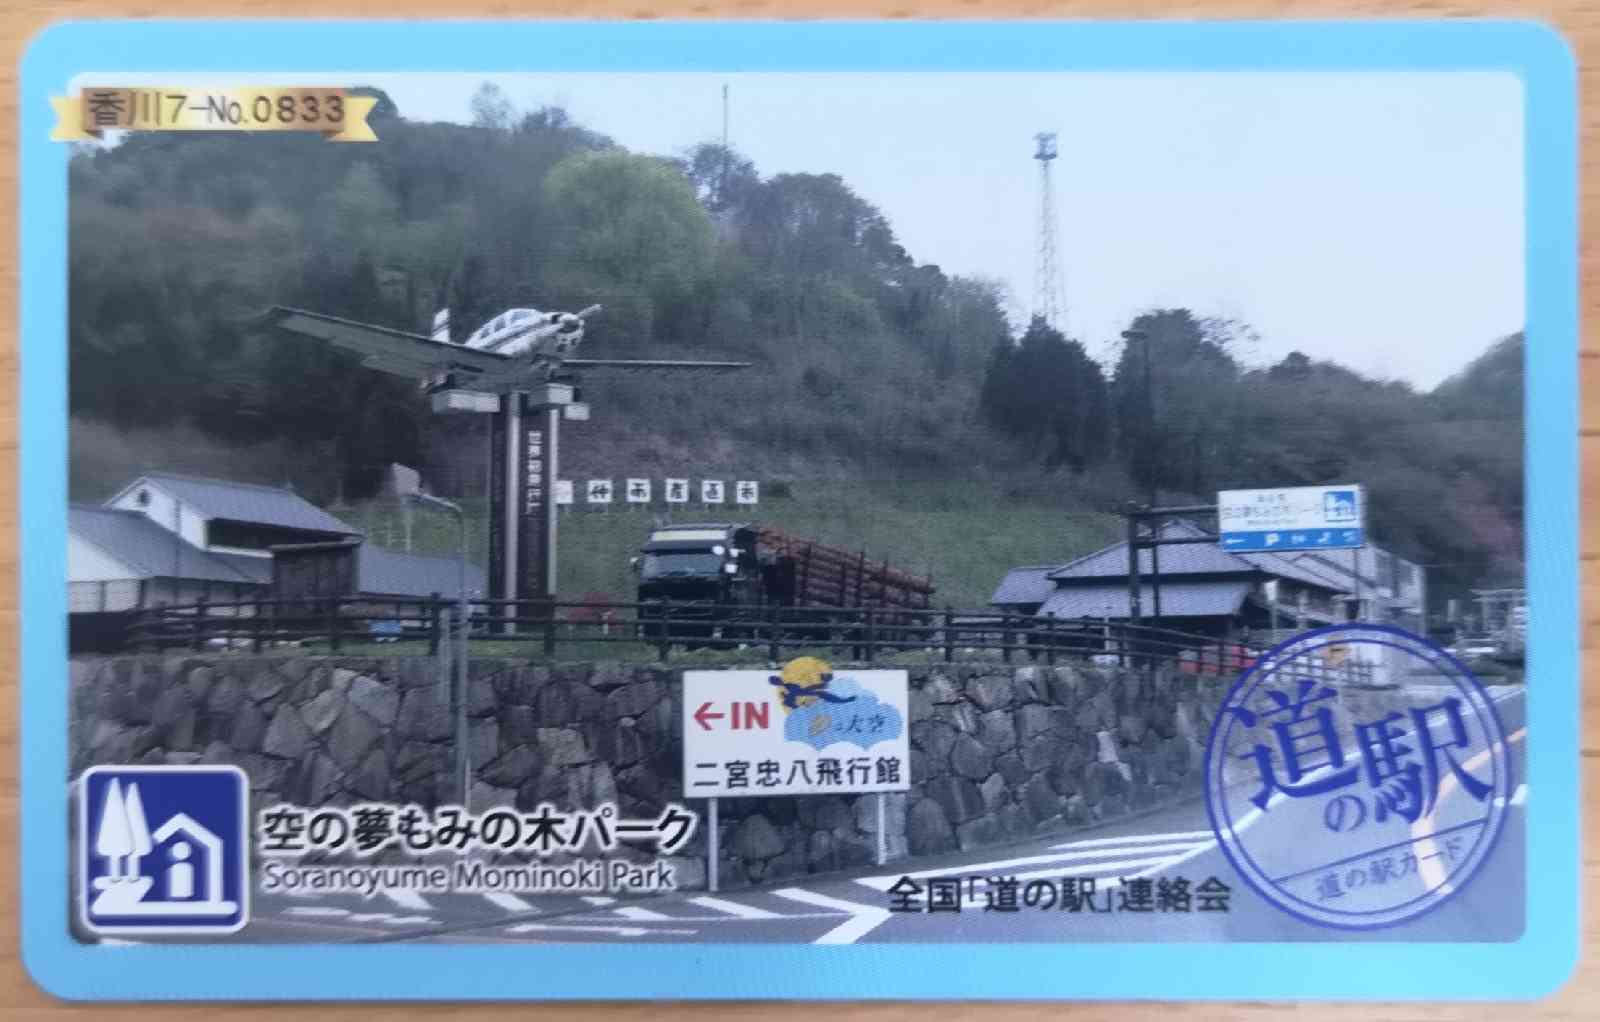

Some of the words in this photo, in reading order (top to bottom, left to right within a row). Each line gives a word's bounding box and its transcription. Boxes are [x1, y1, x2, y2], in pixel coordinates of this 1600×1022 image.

[731, 702, 770, 729] IN
[693, 757, 901, 789] 二宮忠八飛行館
[263, 806, 695, 851] 空の夢もみの木パーク
[264, 862, 446, 892] Soranoyume
[456, 861, 602, 889] Mominoki
[611, 861, 673, 889] Park
[1315, 835, 1465, 902] 道の駅カード
[886, 875, 1232, 914] 全国「道の駅」連絡会
